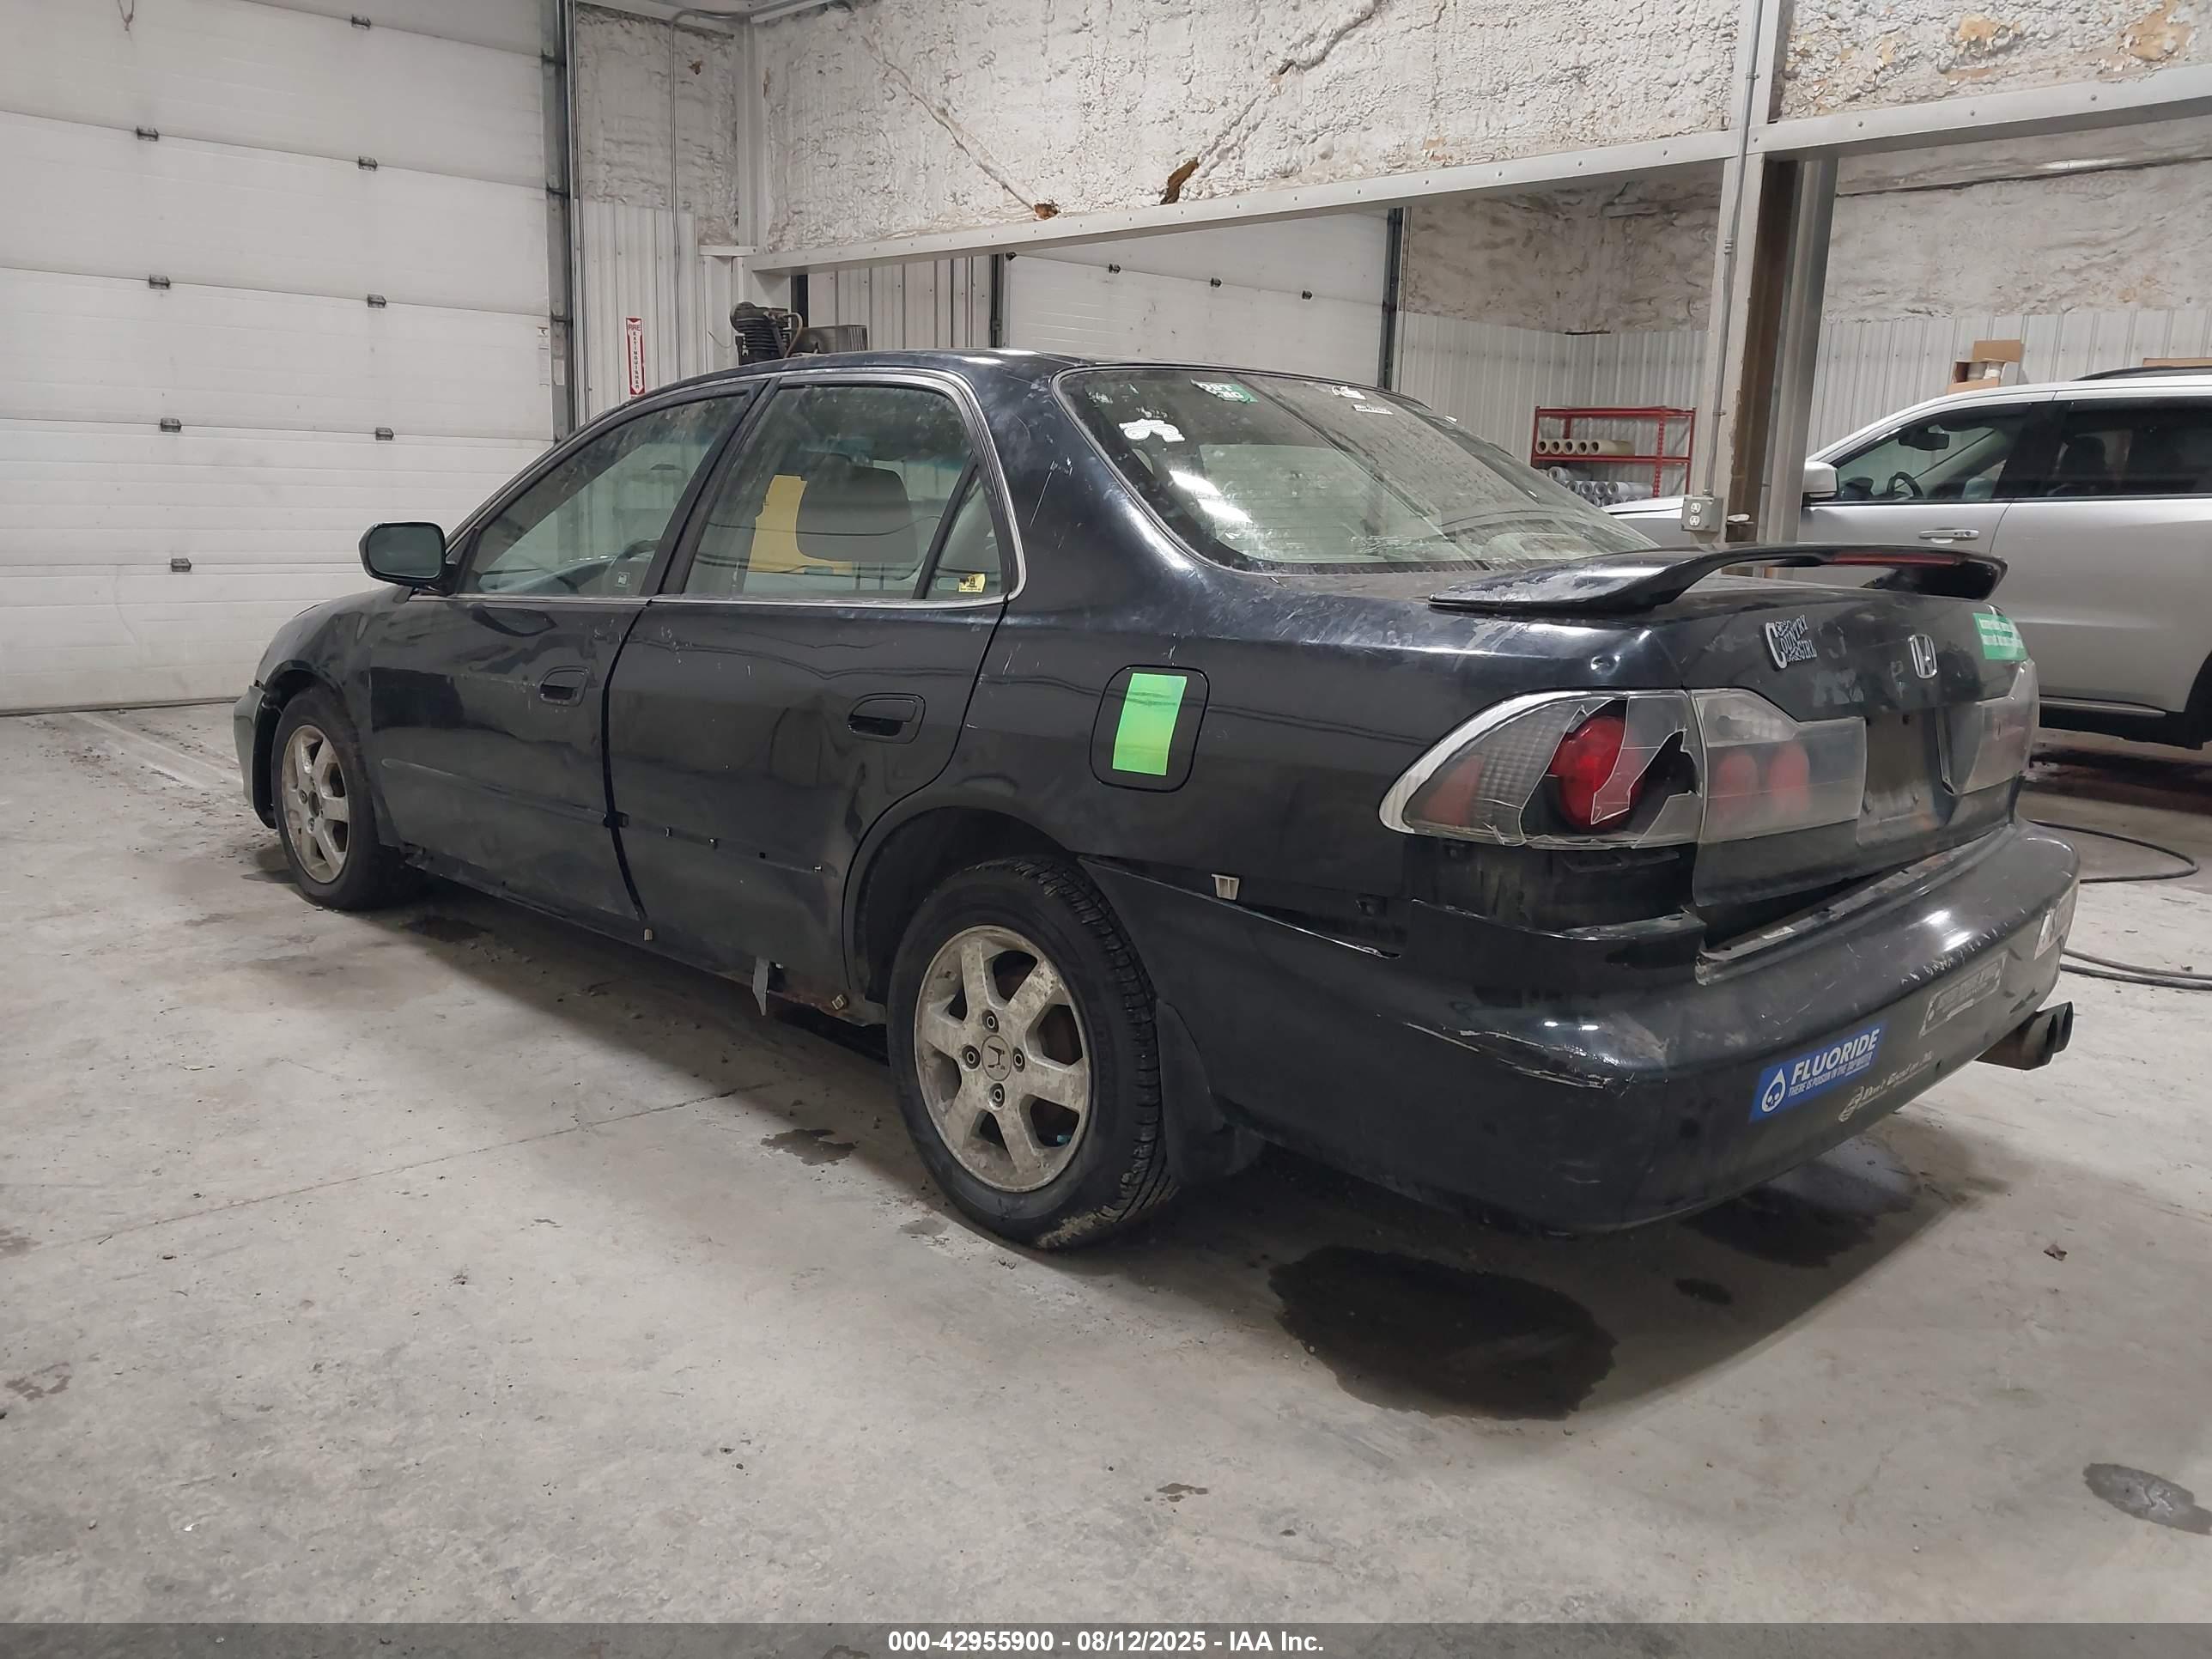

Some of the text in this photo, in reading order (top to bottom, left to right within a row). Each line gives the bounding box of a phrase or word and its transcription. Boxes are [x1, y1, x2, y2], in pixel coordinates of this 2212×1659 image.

[1765, 612, 1809, 669] COUNTRY
[1796, 639, 1818, 660] GIRL
[1790, 1028, 1881, 1086] FLUORIDE
